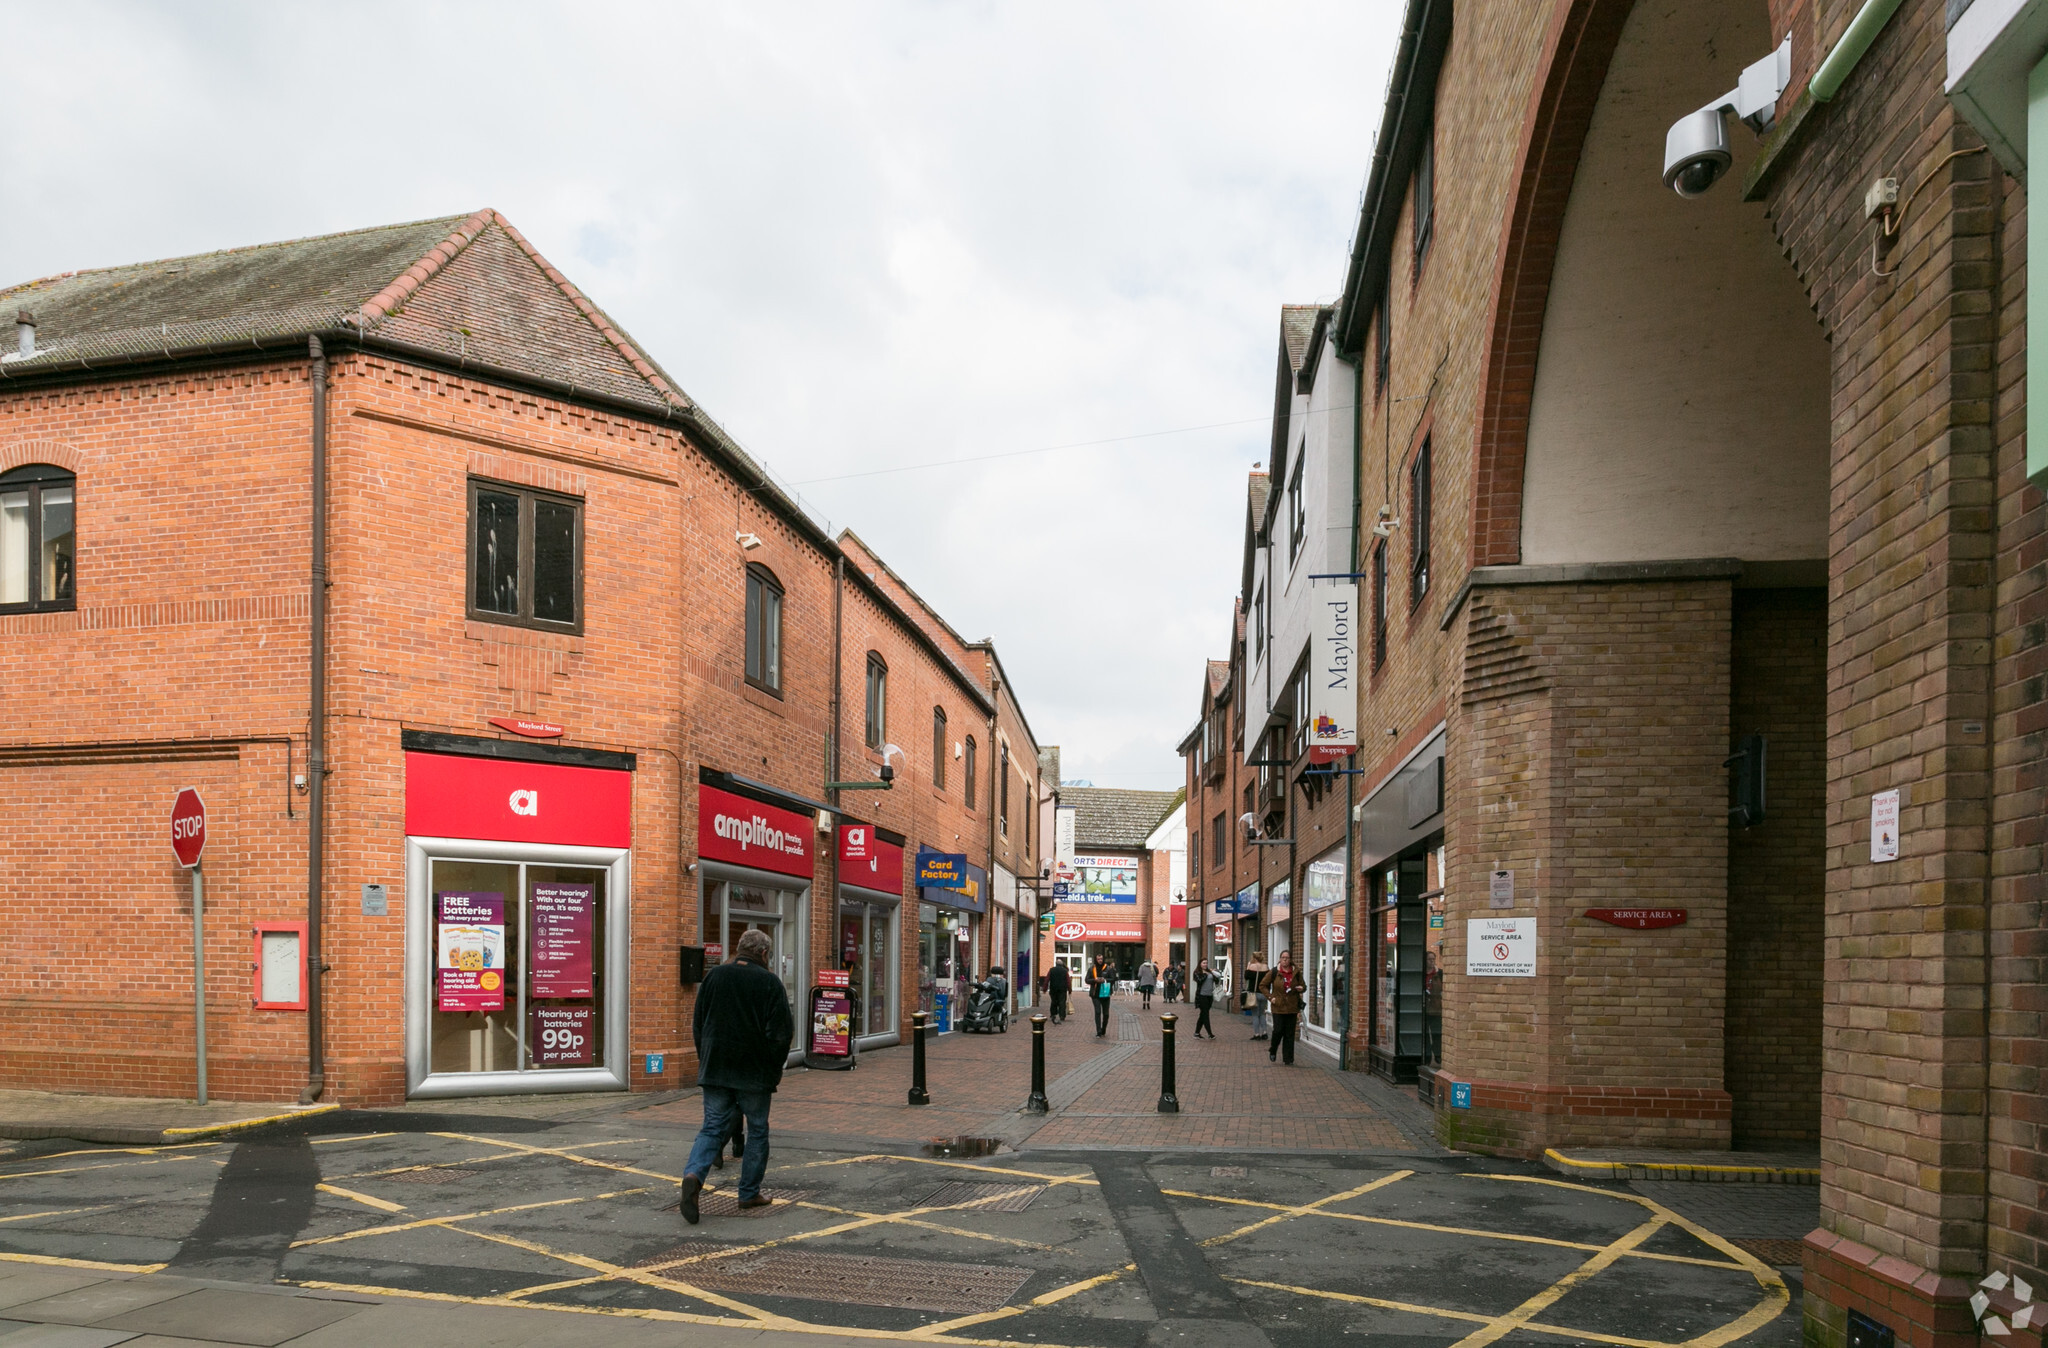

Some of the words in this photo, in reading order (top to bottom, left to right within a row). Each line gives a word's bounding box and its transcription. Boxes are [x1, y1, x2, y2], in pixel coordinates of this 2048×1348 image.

[1327, 601, 1353, 690] Maylord
[1320, 746, 1347, 755] Shopping
[1889, 796, 1898, 805] you
[174, 815, 203, 840] STOP
[1875, 818, 1895, 827] smoking
[714, 813, 784, 851] amplifon
[1063, 816, 1073, 851] Maylord
[785, 832, 802, 846] Hearing
[785, 845, 804, 856] specialist
[929, 860, 952, 869] Card
[1074, 857, 1096, 865] ORTS
[921, 870, 959, 881] Factory
[559, 890, 589, 898] hearing?
[443, 897, 470, 906] FREE
[443, 906, 492, 915] batteries
[1487, 920, 1516, 930] Maylord
[538, 1010, 573, 1020] Hearing
[574, 1010, 588, 1018] aid
[543, 1020, 582, 1028] batteries
[542, 1029, 584, 1049] 99p
[543, 1052, 559, 1060] per
[561, 1050, 582, 1060] pack
[1456, 1091, 1466, 1099] SV
